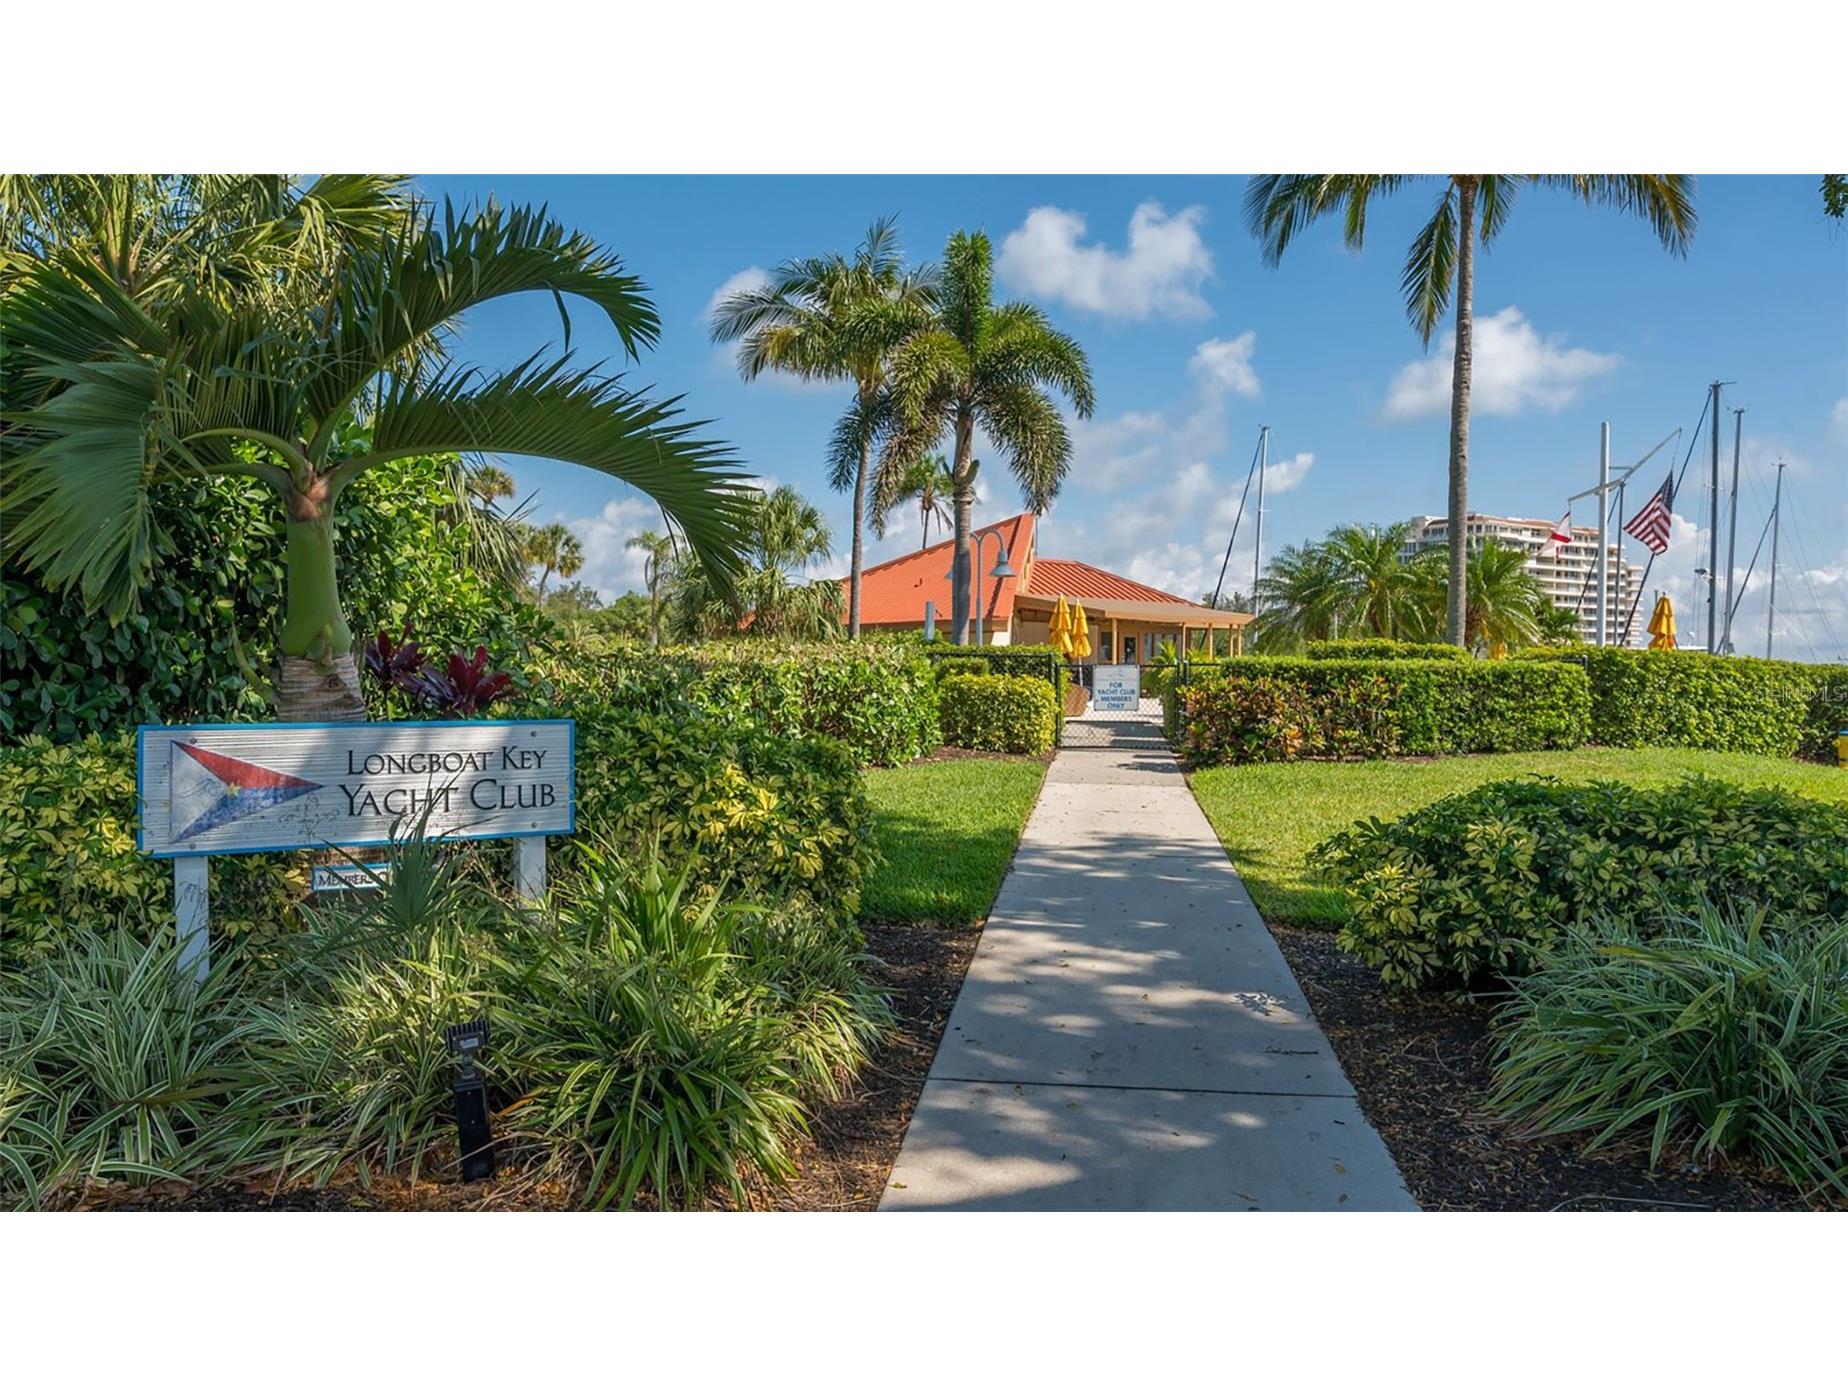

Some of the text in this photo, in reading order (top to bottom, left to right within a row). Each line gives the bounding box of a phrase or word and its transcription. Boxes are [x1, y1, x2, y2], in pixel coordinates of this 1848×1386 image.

[347, 745, 547, 776] LONGBOAT KEY
[470, 778, 555, 811] CLUB
